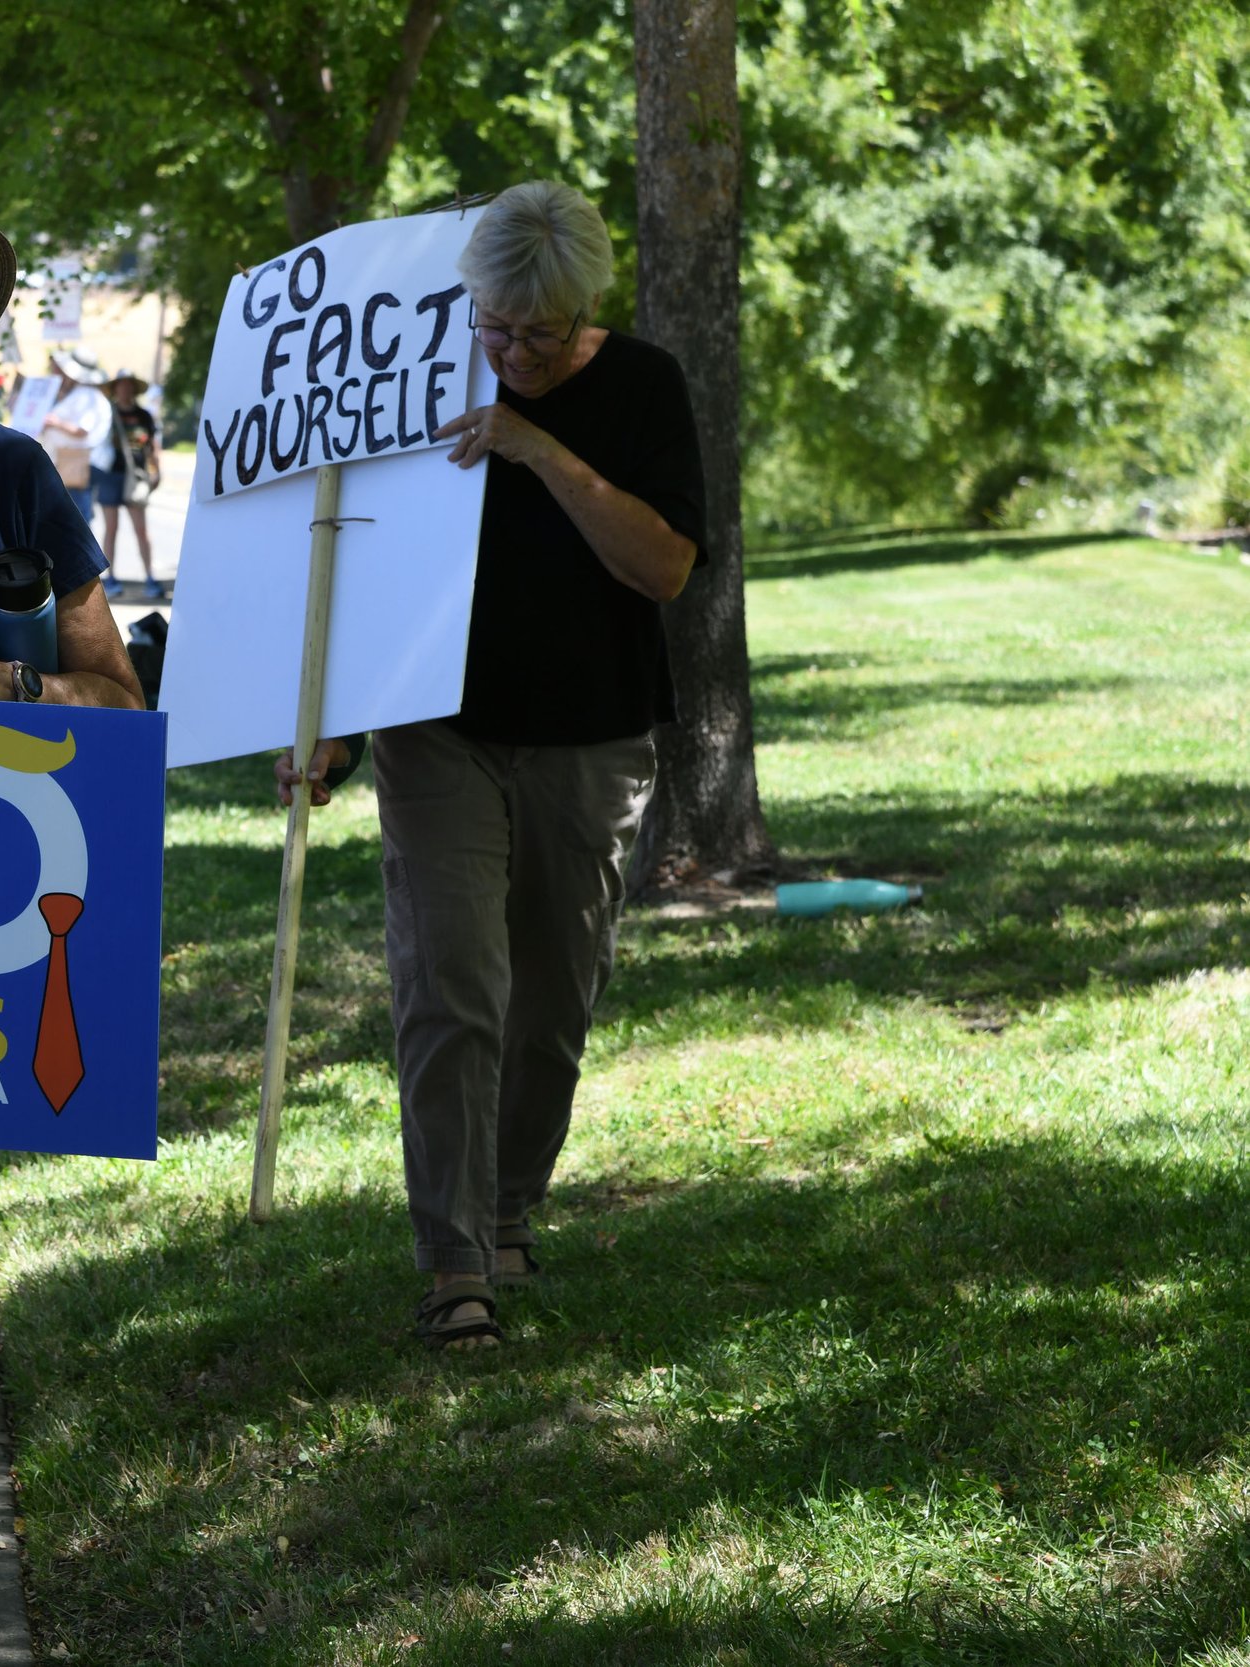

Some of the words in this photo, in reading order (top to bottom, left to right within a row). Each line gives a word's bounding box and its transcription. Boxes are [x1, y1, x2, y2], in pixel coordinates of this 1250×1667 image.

[243, 246, 326, 329] GO
[261, 283, 467, 398] FACT
[204, 362, 456, 496] YOURSELF
